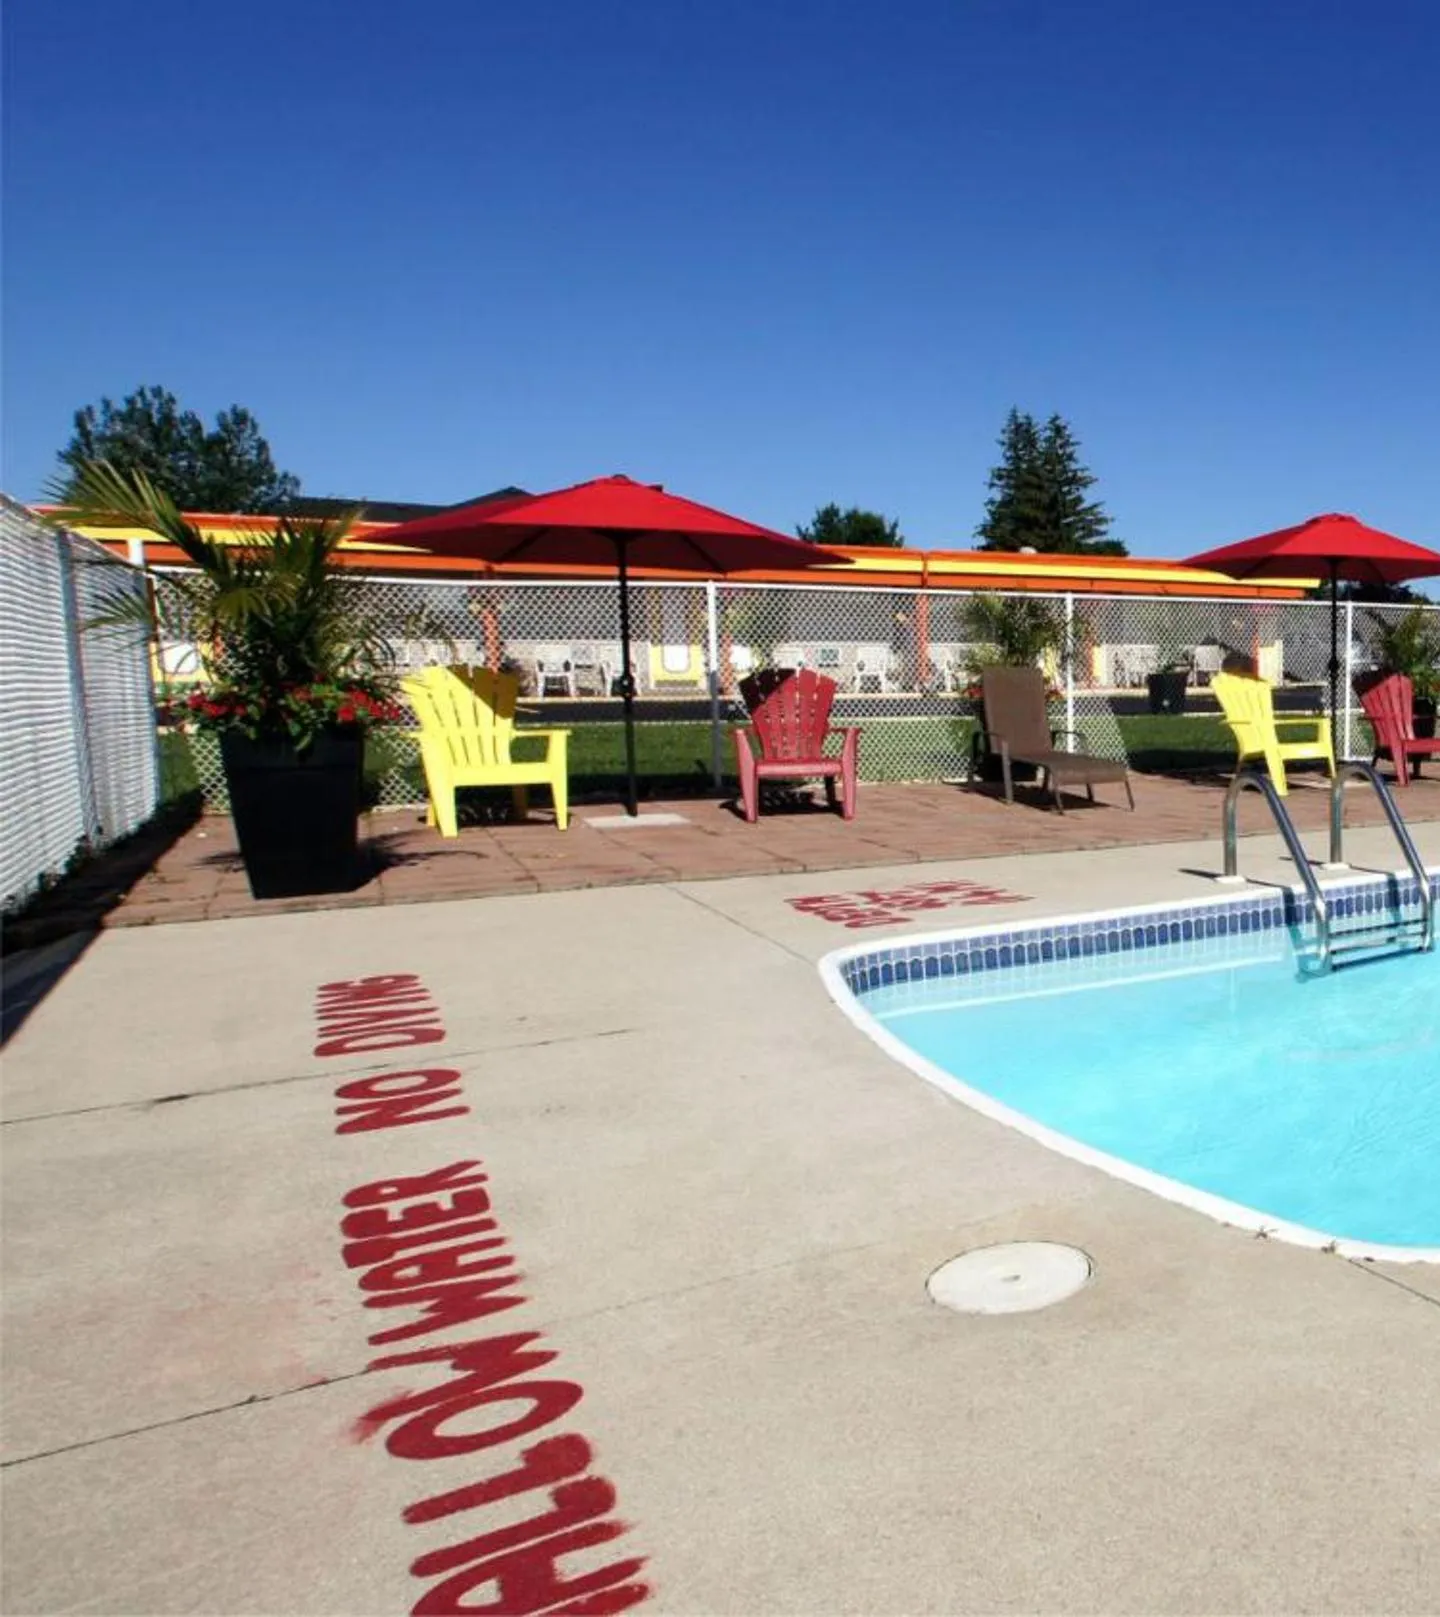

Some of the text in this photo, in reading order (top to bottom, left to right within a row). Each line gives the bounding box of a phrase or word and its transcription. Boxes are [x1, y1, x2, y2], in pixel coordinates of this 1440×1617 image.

[314, 973, 652, 1617] ALLOW WATER NO DIVING
